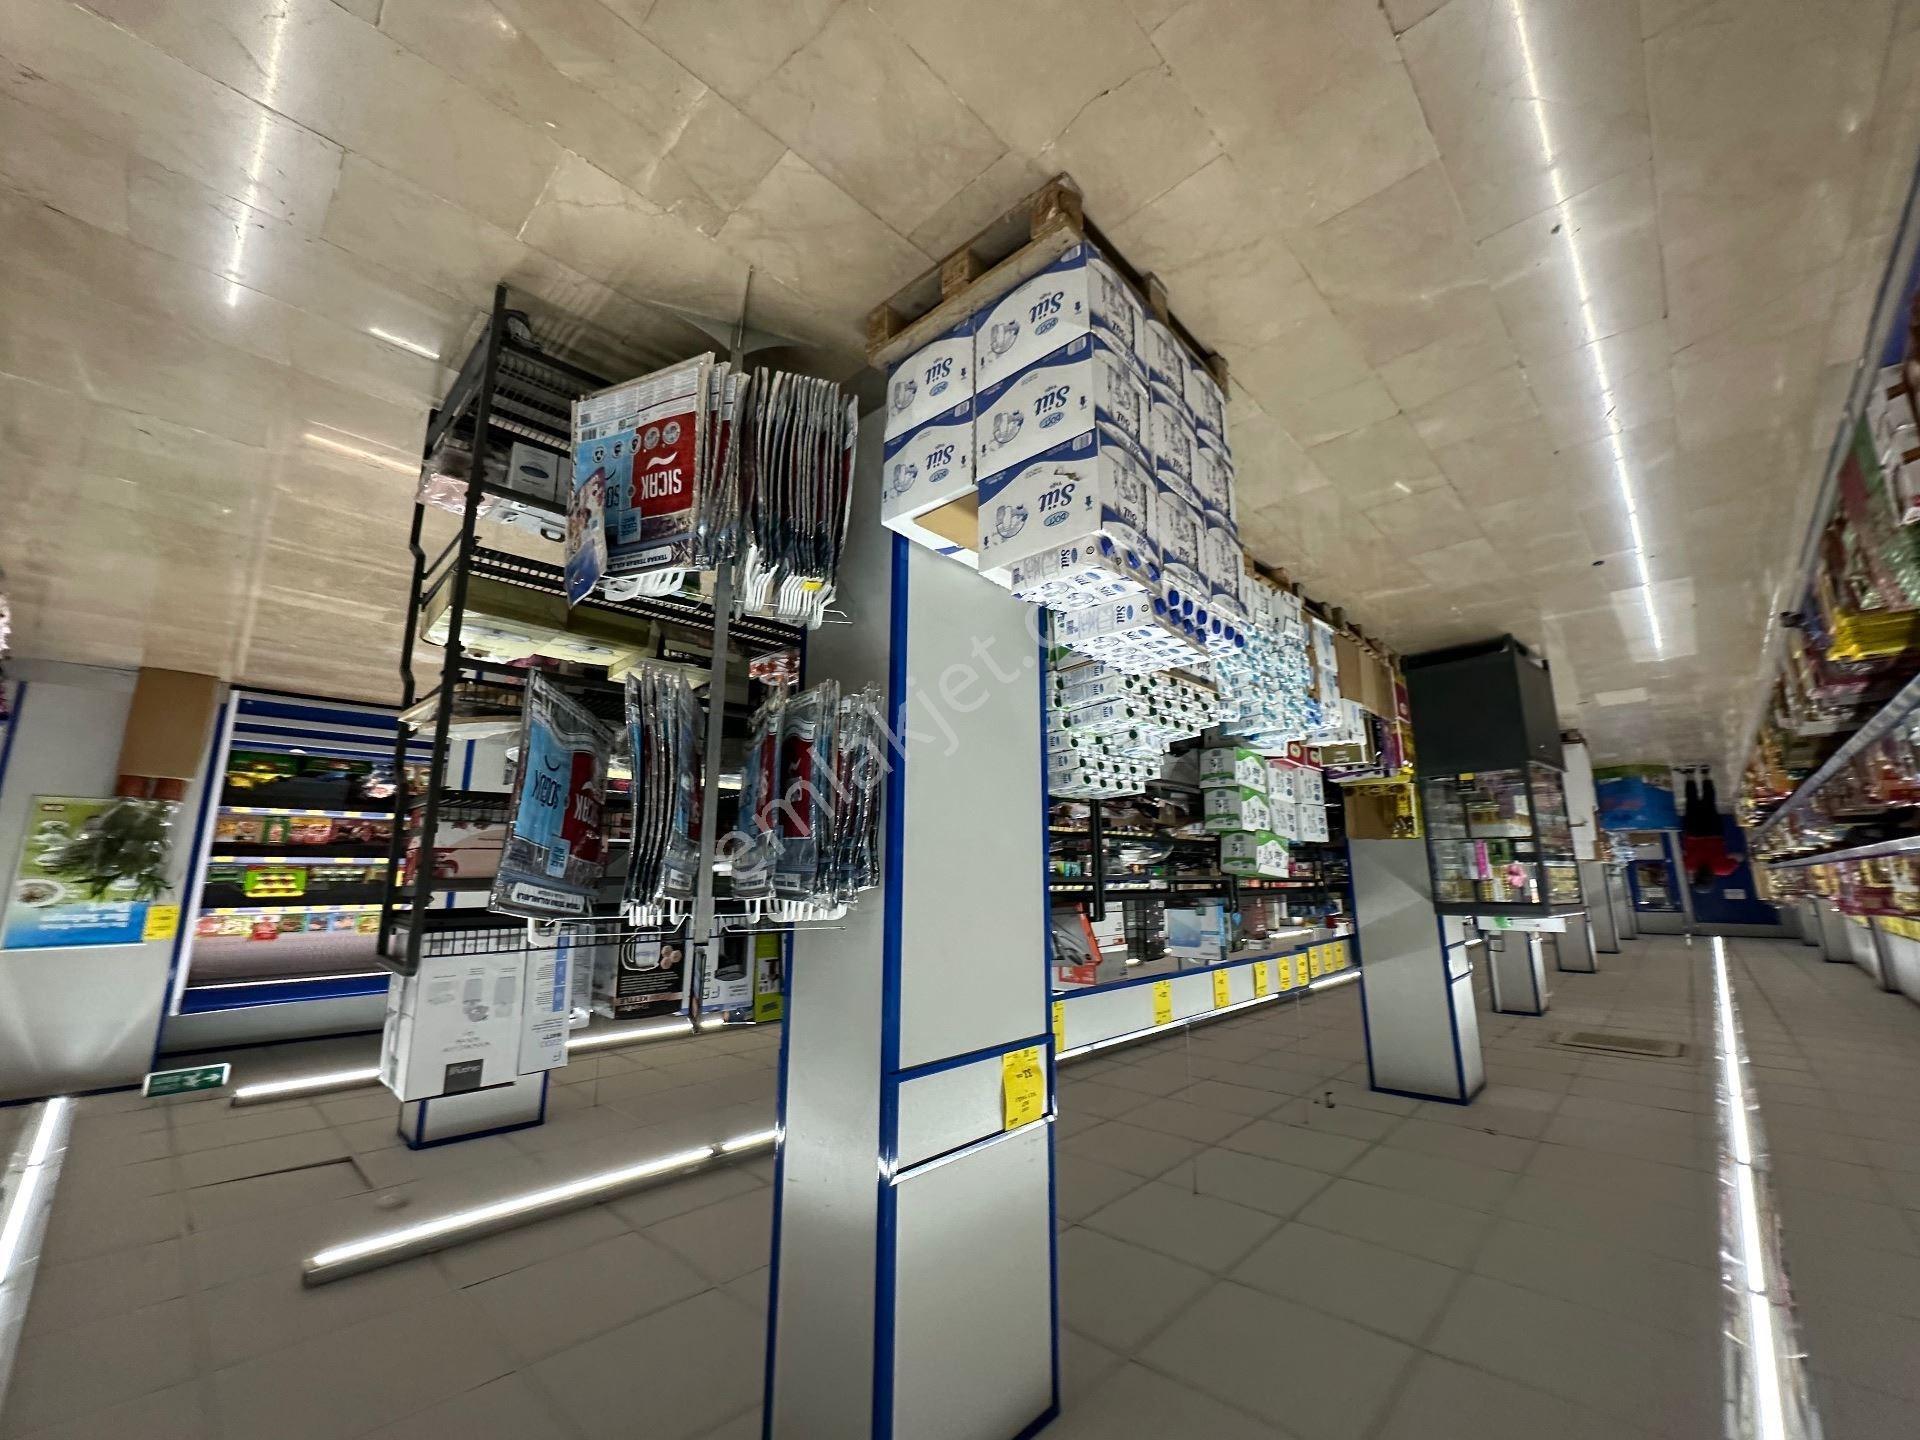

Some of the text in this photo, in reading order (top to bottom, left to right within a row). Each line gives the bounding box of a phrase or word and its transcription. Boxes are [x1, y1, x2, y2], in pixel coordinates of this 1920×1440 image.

[1029, 291, 1064, 324] Süt
[925, 357, 953, 385] Süt
[1034, 385, 1070, 417] Süt
[925, 444, 955, 471] Süt
[641, 469, 682, 500] SICAK
[1038, 484, 1075, 513] Süt
